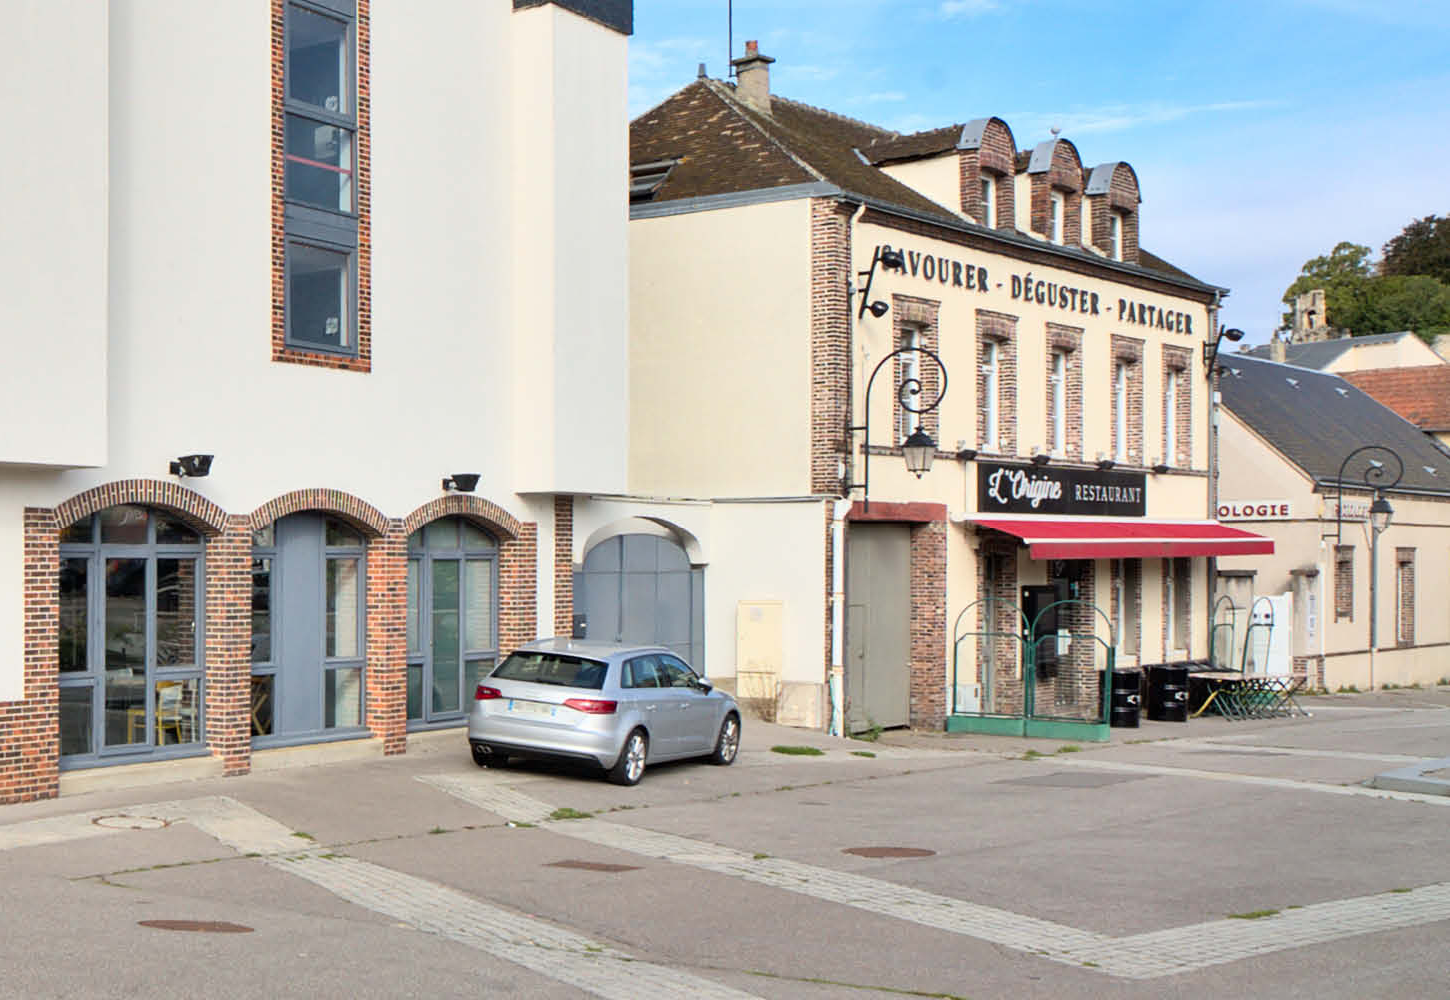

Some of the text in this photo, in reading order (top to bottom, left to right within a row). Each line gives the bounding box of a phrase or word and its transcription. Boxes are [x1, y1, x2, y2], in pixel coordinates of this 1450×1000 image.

[1011, 272, 1099, 315] DÉGUSTER
[1118, 298, 1193, 335] PARTAGER
[988, 467, 1142, 508] L'Origine RESTAURANT
